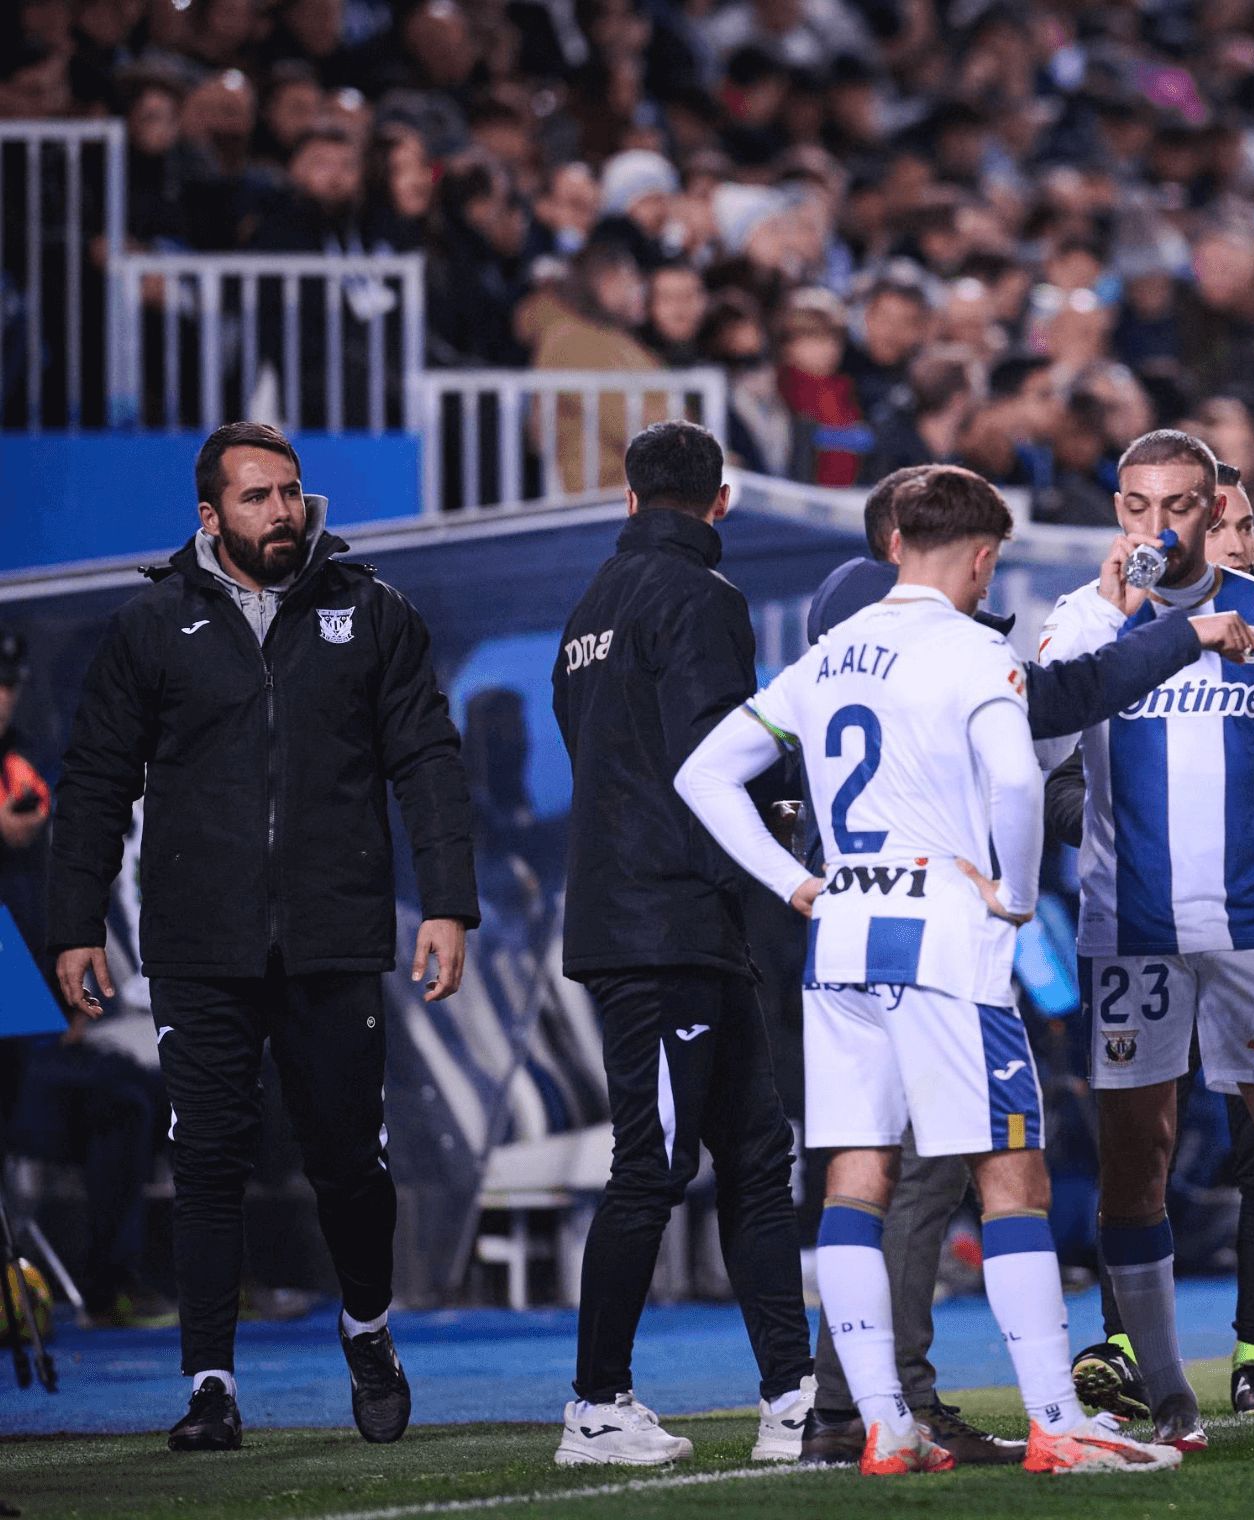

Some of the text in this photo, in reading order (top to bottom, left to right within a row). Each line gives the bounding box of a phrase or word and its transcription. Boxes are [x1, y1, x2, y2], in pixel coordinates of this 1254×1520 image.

[816, 643, 899, 684] A.ALTI
[825, 703, 889, 855] 2
[820, 857, 928, 898] owi
[1100, 963, 1170, 1024] 23
